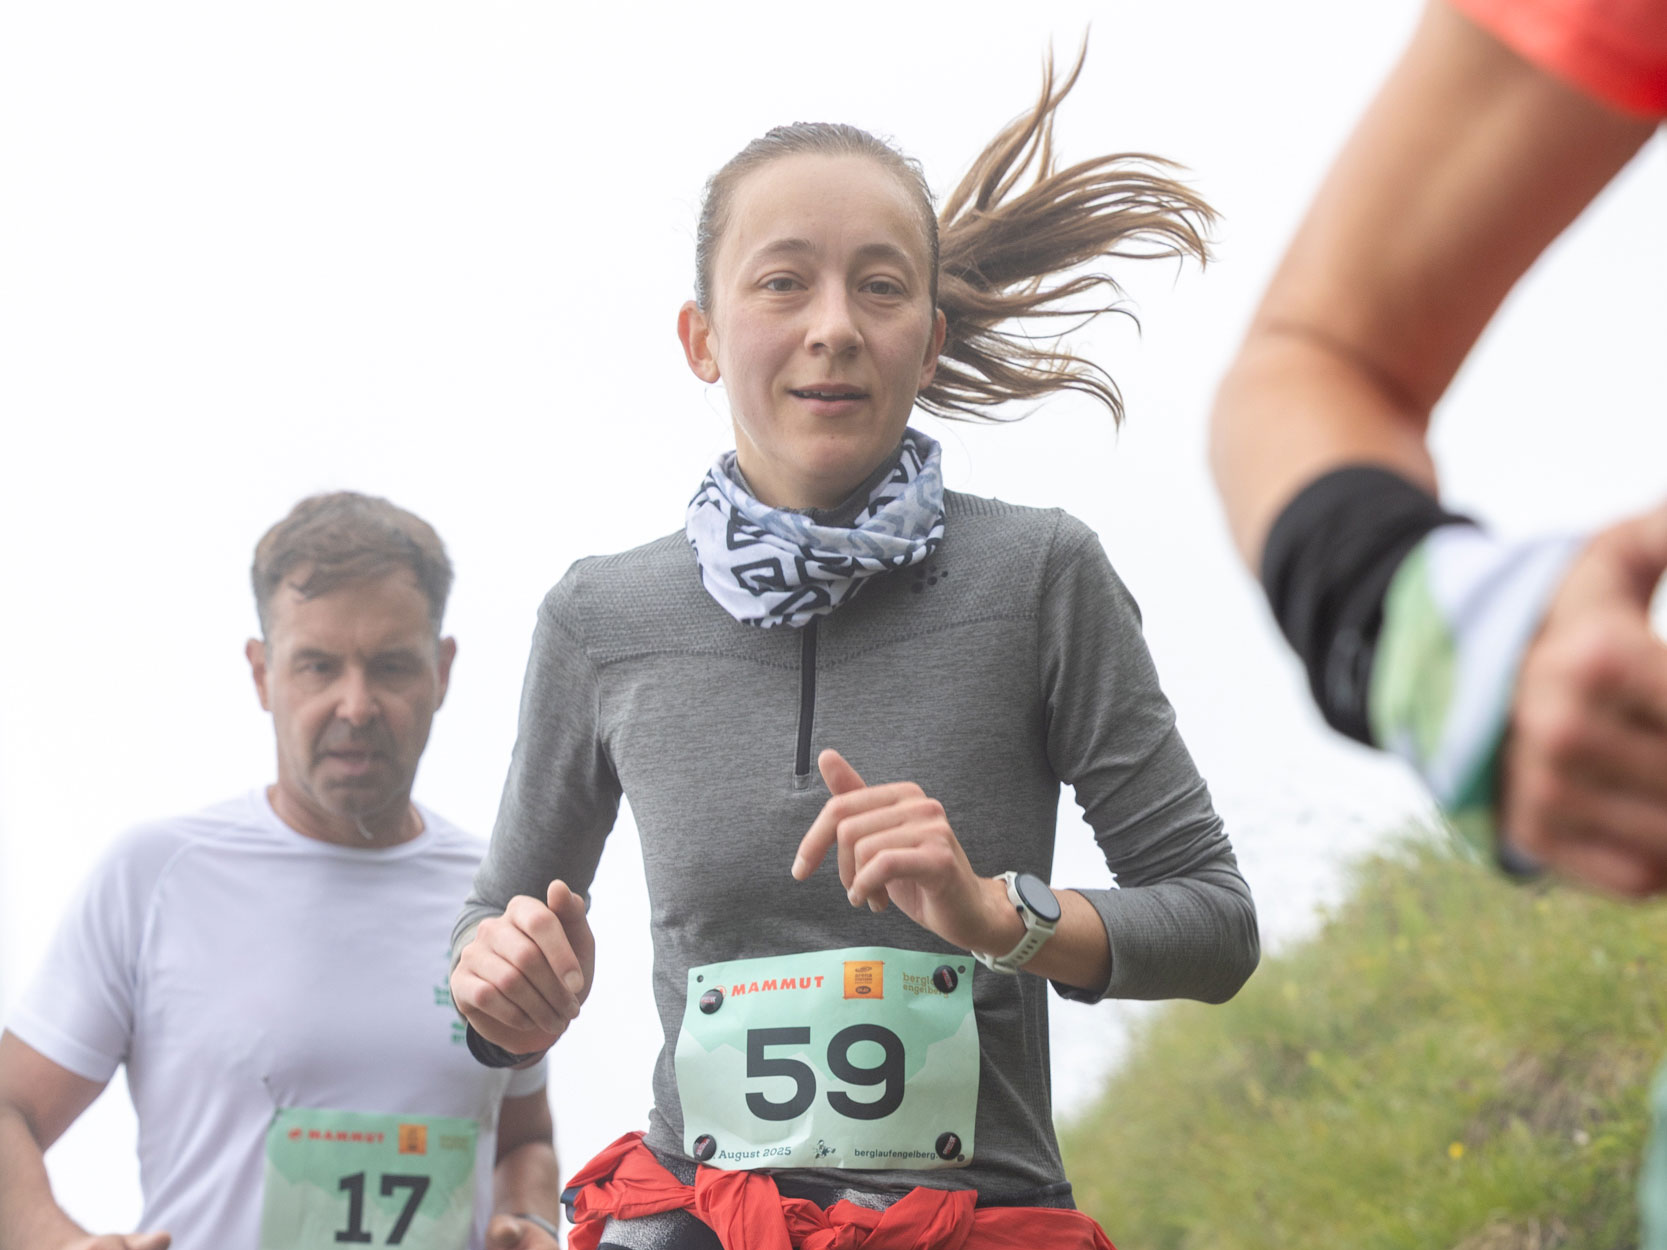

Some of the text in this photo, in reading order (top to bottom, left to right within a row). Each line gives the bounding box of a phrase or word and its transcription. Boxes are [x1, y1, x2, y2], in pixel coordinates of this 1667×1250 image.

[731, 975, 825, 997] MAMMUT
[903, 971, 935, 987] bergl
[745, 1023, 906, 1121] 59
[718, 1146, 792, 1162] August 2025
[854, 1149, 939, 1160] berglaufengelberg.
[334, 1170, 431, 1246] 17
